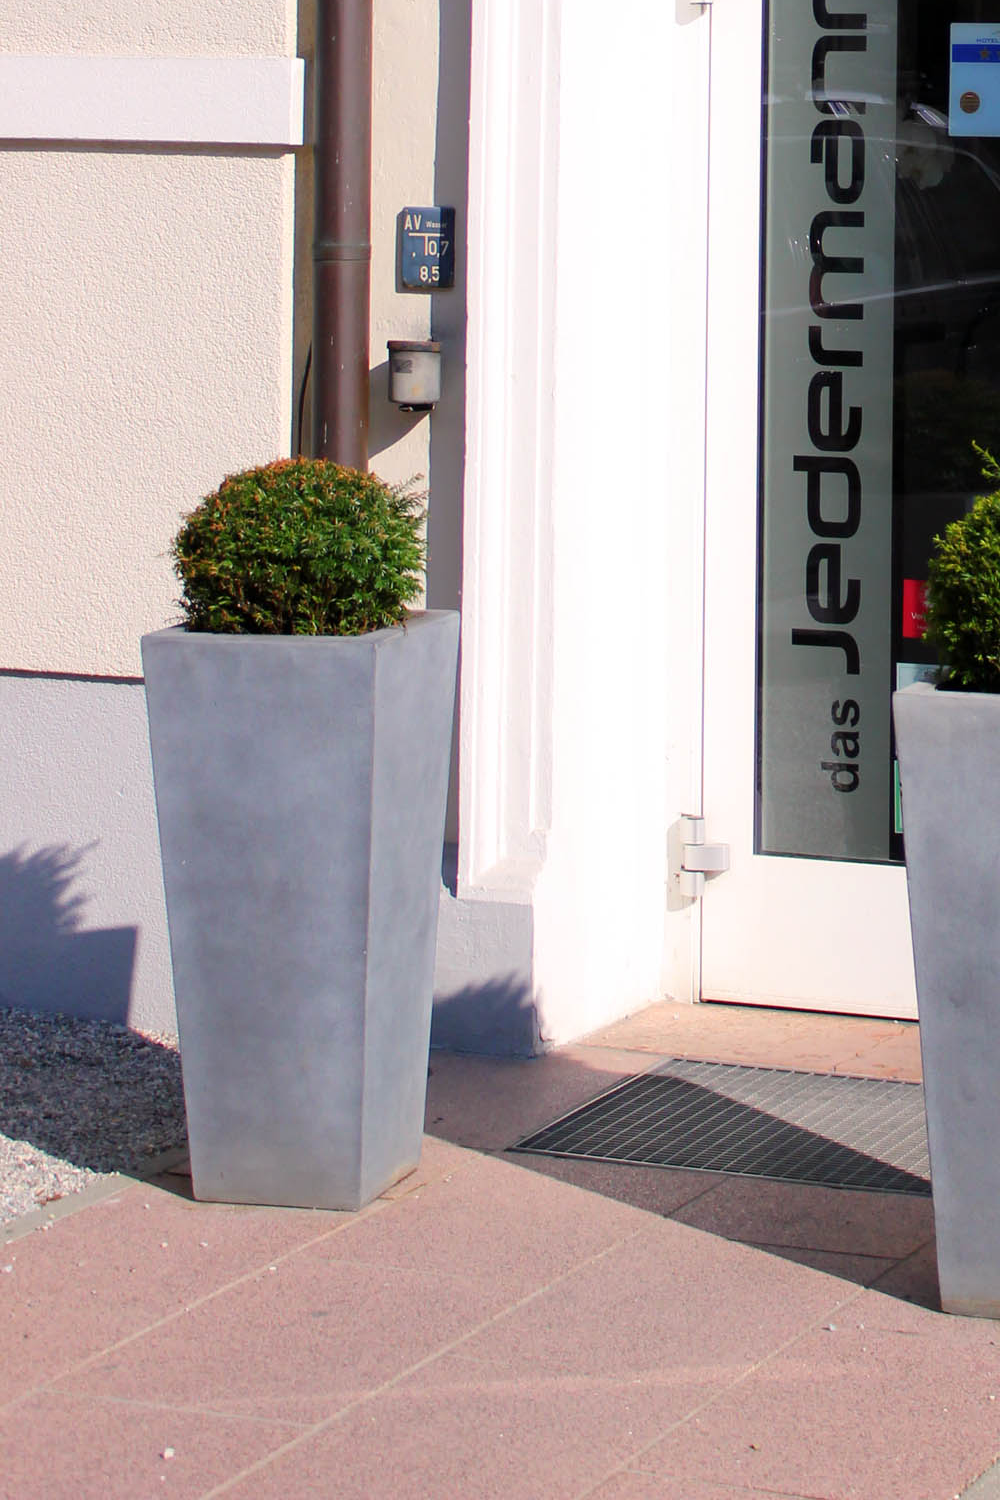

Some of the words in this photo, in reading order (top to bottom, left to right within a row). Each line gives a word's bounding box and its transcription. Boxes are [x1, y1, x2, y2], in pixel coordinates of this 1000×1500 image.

[404, 214, 422, 231] AV
[420, 265, 440, 283] 8,5
[821, 699, 859, 793] das
